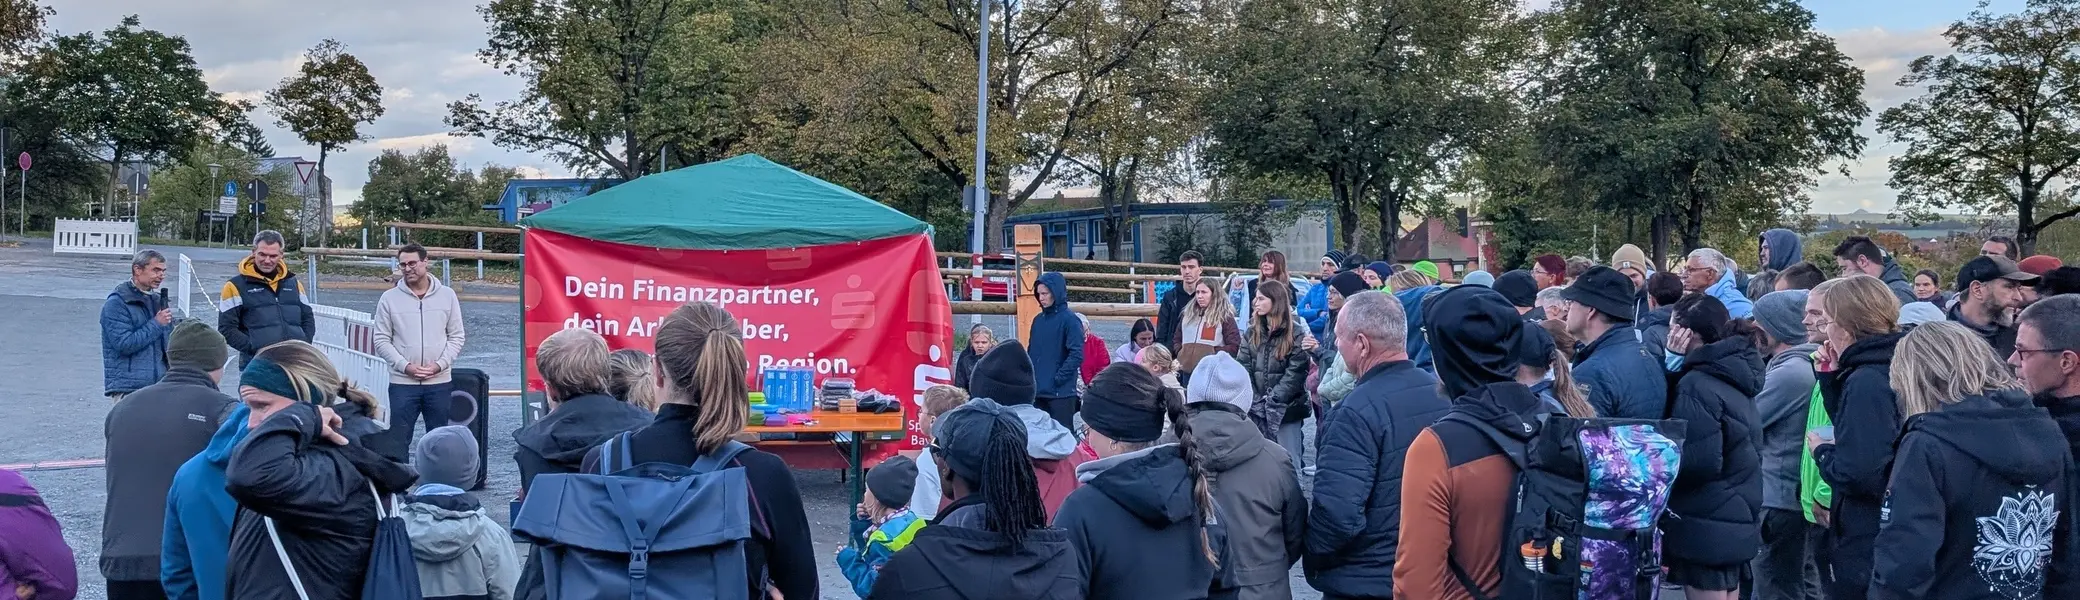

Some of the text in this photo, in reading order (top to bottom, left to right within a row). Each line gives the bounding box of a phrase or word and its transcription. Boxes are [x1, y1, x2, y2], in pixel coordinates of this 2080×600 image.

[565, 275, 818, 307] Dein Finanzpartner,
[563, 312, 619, 336] dein
